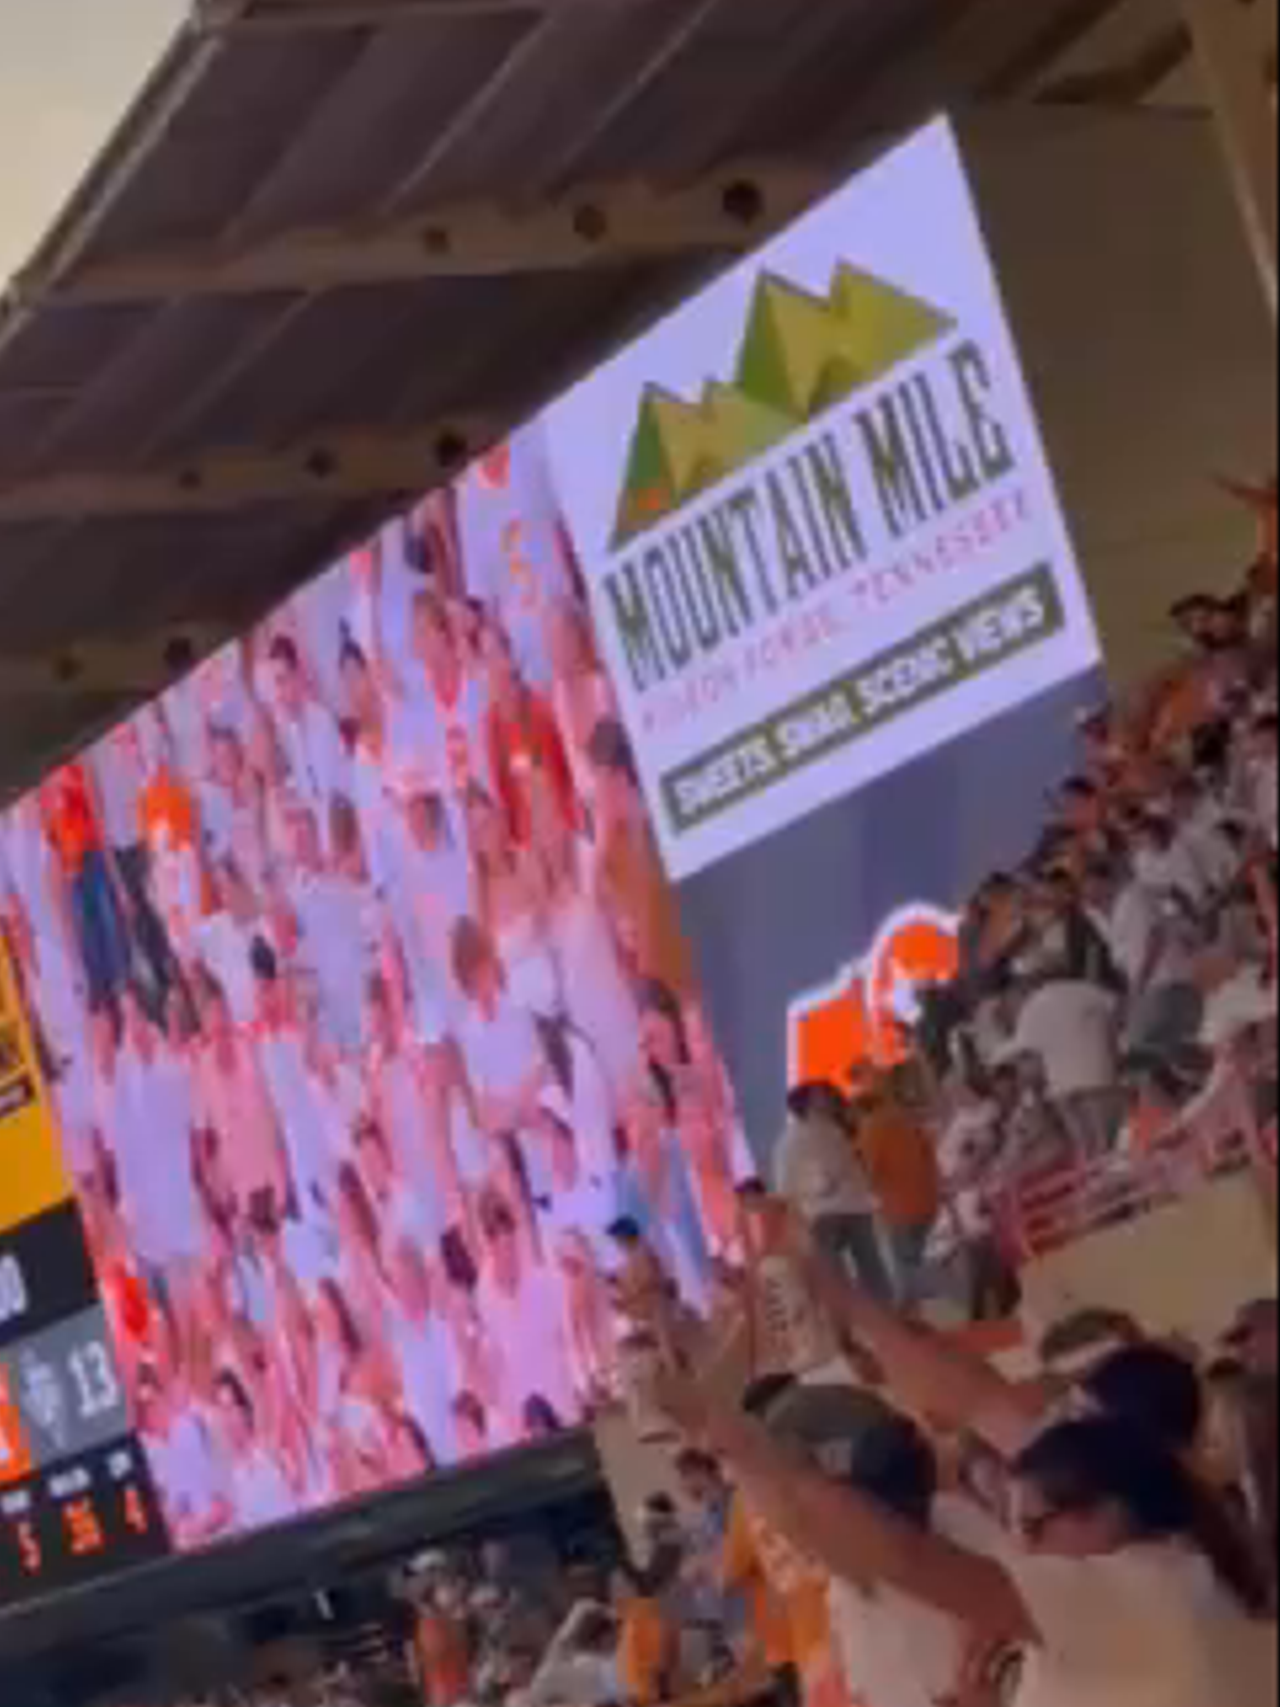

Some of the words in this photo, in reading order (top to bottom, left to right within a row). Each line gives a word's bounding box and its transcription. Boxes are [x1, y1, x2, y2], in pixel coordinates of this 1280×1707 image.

[602, 431, 869, 693] MOUNTAIN
[852, 339, 1017, 540] MILE
[952, 584, 1046, 663] VIEWS
[68, 1339, 121, 1420] 13
